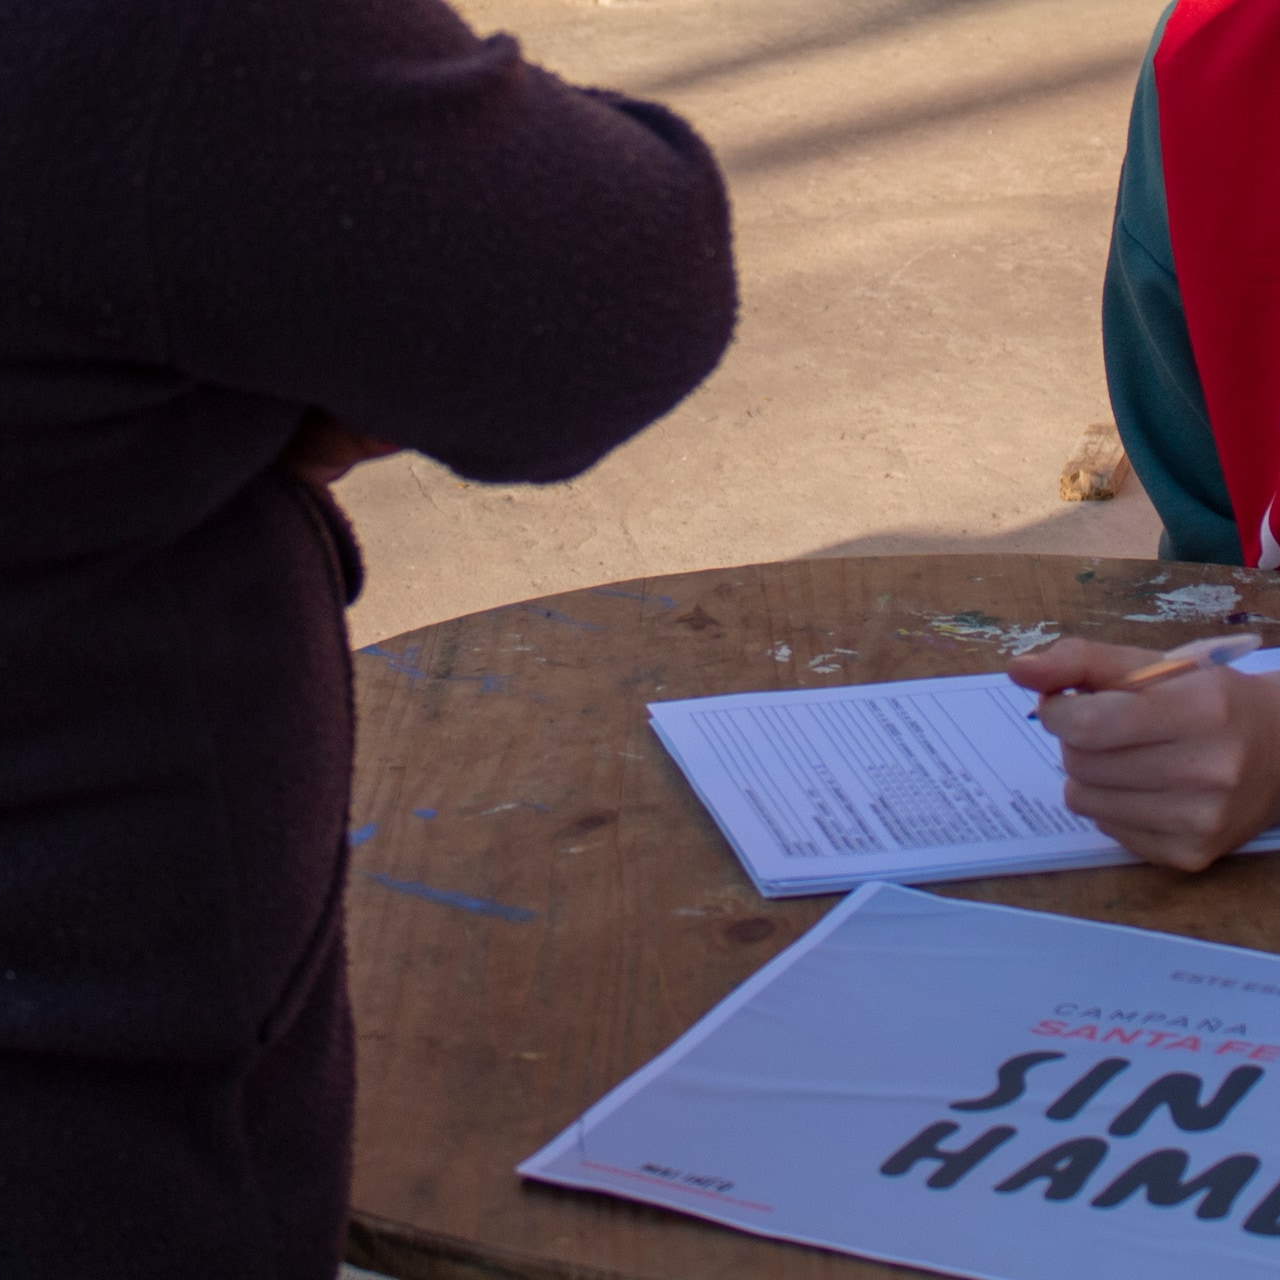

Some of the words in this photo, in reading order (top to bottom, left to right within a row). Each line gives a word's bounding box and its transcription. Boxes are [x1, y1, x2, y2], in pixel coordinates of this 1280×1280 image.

[1170, 969, 1238, 989] ESTE
[1030, 1019, 1202, 1053] SANTA
[1054, 1002, 1247, 1036] CAMPAÑA
[947, 1049, 1266, 1138] SIN
